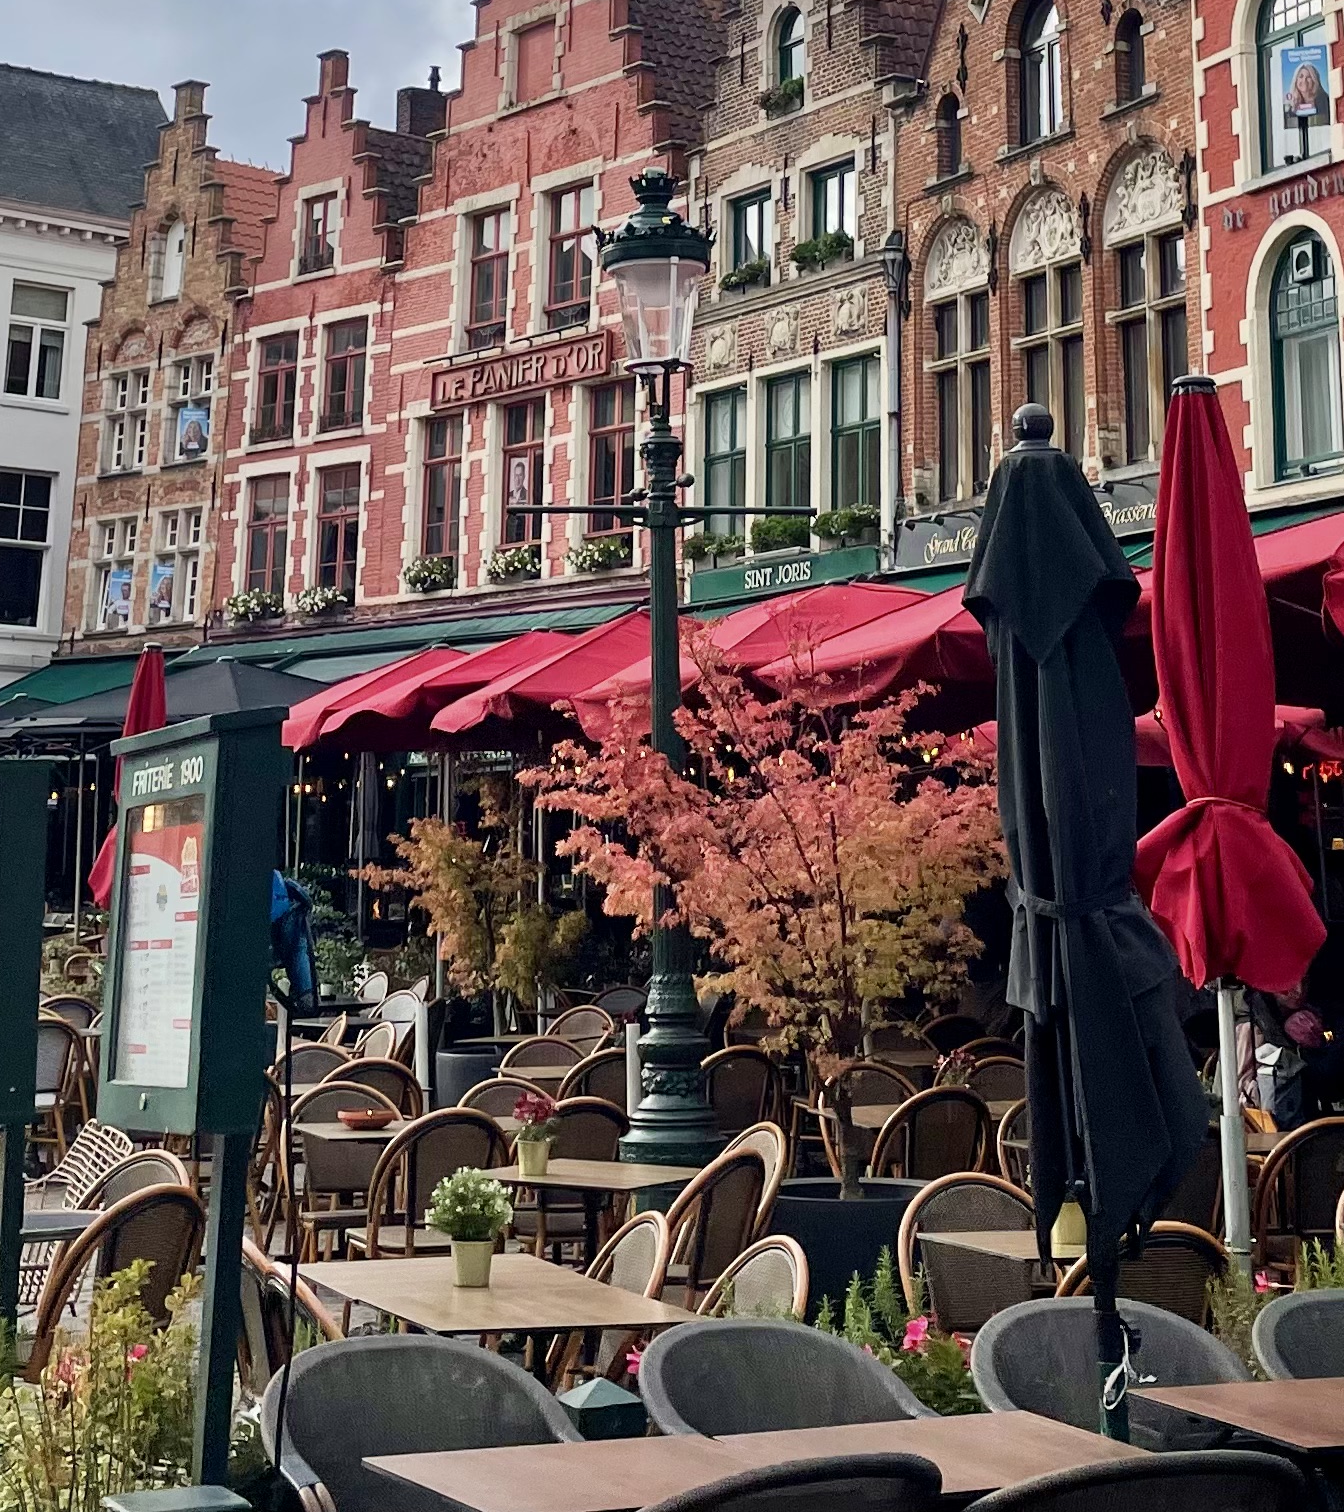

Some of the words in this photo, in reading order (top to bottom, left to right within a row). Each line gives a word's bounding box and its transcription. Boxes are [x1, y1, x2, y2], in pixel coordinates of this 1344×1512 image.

[1222, 206, 1245, 232] de
[1269, 173, 1344, 219] gouden
[440, 377, 465, 404] LE
[470, 353, 548, 399] PANIER
[552, 340, 604, 380] D'OR
[923, 529, 961, 564] Grand
[744, 567, 773, 589] SINT
[775, 560, 811, 585] JORIS
[131, 756, 175, 797] FRITERIE
[180, 755, 204, 786] 1900
